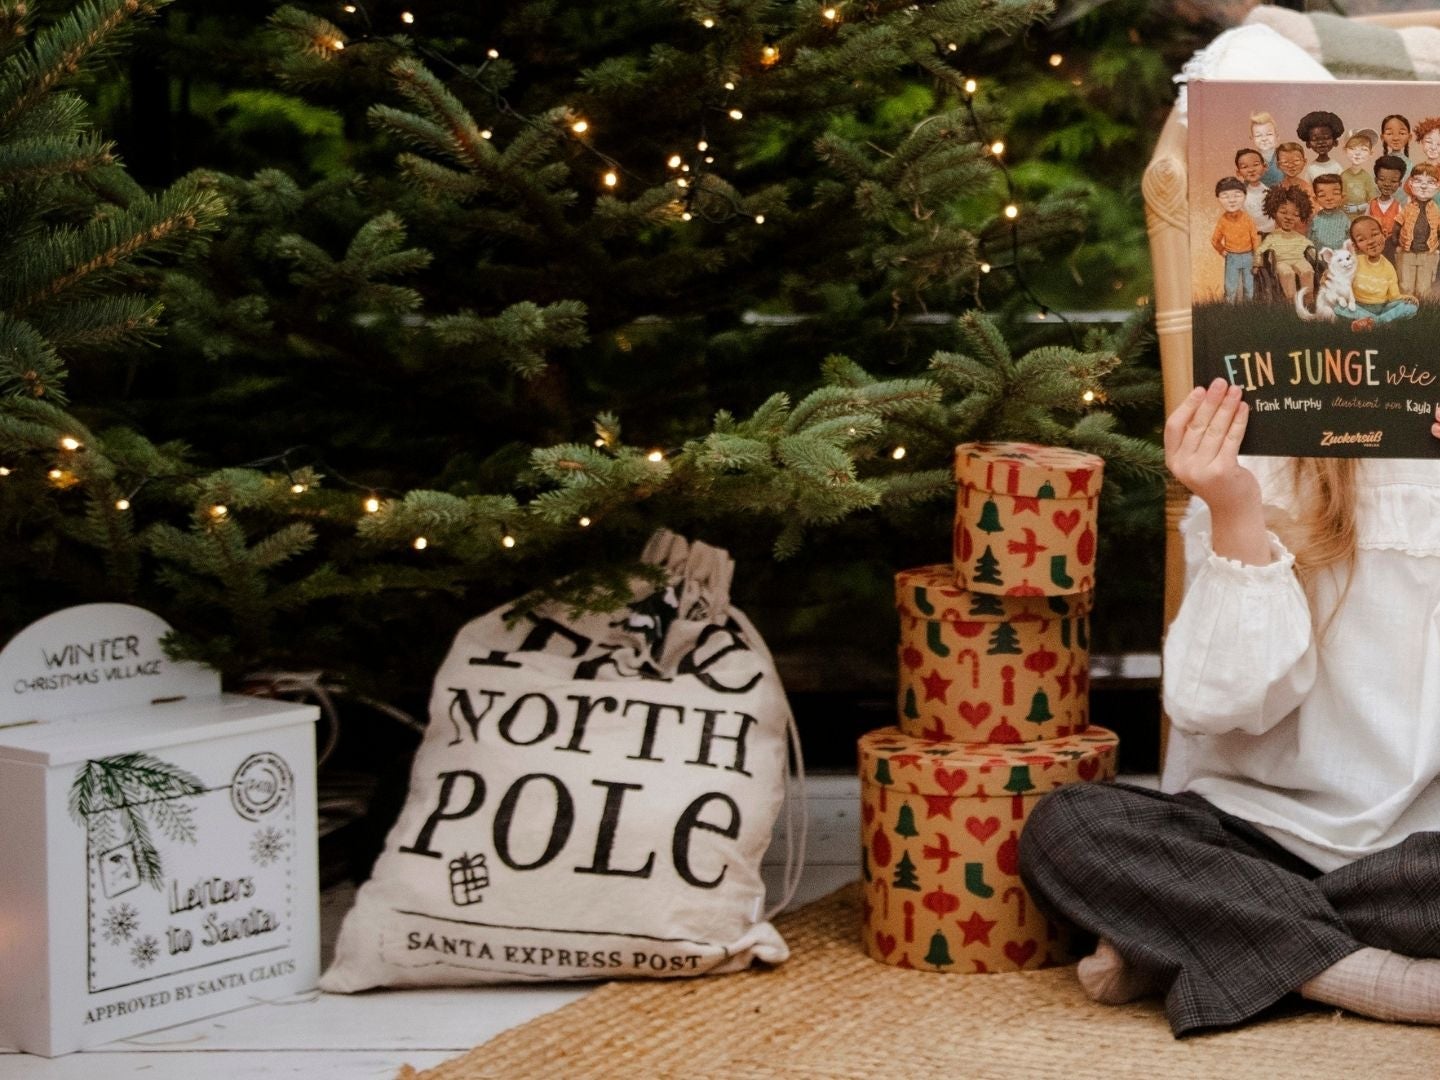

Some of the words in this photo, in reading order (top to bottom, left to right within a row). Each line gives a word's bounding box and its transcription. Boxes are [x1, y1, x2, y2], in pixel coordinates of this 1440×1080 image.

[1224, 351, 1275, 391] EIN
[1288, 348, 1380, 387] JUNGE
[1386, 361, 1437, 387] wie
[1255, 398, 1280, 412] Frank
[1284, 396, 1322, 412] Murphy
[1406, 399, 1431, 414] Kayla
[1320, 430, 1383, 447] Zuckersüß
[42, 634, 140, 669] WINTER
[13, 669, 100, 694] CHRISTMAS
[104, 659, 163, 681] VILLAGE
[168, 876, 257, 915] Letters
[165, 926, 193, 956] to
[201, 907, 280, 947] Santa
[407, 932, 494, 960] SANTA
[503, 946, 624, 968] EXPRESS
[632, 951, 702, 971] POST
[84, 993, 172, 1026] APPROVED
[176, 983, 196, 1002] BY
[196, 973, 248, 997] SANTA
[249, 958, 296, 984] CLAUS
